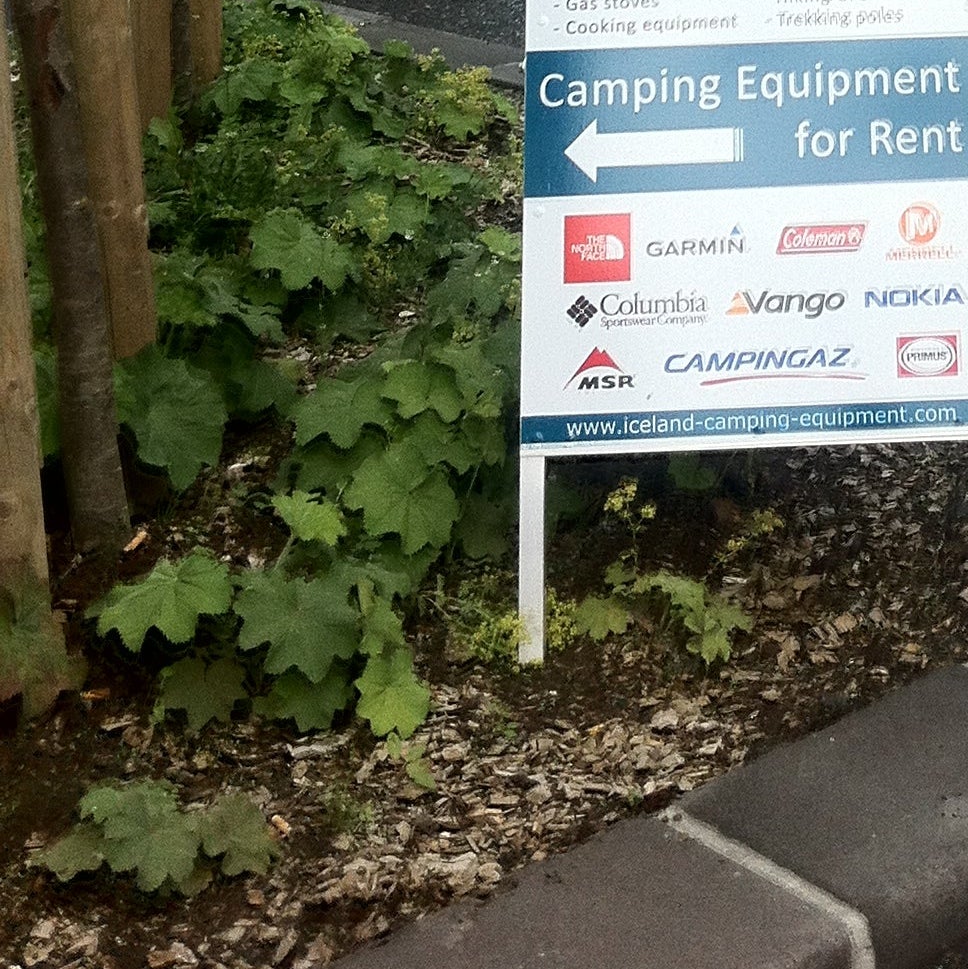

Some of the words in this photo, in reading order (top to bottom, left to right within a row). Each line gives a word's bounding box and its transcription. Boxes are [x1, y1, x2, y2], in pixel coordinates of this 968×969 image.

[565, 17, 637, 35] Cooking
[642, 14, 739, 34] equipment
[776, 9, 852, 28] Trekking
[856, 6, 904, 28] poles
[538, 68, 721, 113] Camping
[737, 59, 961, 107] Equipment
[794, 120, 854, 158] for
[870, 119, 964, 155] Rent
[571, 243, 605, 253] NORTH
[586, 234, 605, 244] THE
[646, 237, 745, 257] GARMIN
[783, 227, 847, 248] Coleman
[580, 252, 605, 261] FACE
[600, 289, 708, 316] Columbia
[744, 290, 846, 320] Vango
[865, 287, 965, 308] NOKIA
[600, 316, 656, 330] Sportswear
[664, 348, 851, 374] CAMPINGAZ
[577, 375, 634, 390] MSR
[566, 406, 958, 436] www.iceland-camping-equipment.com
